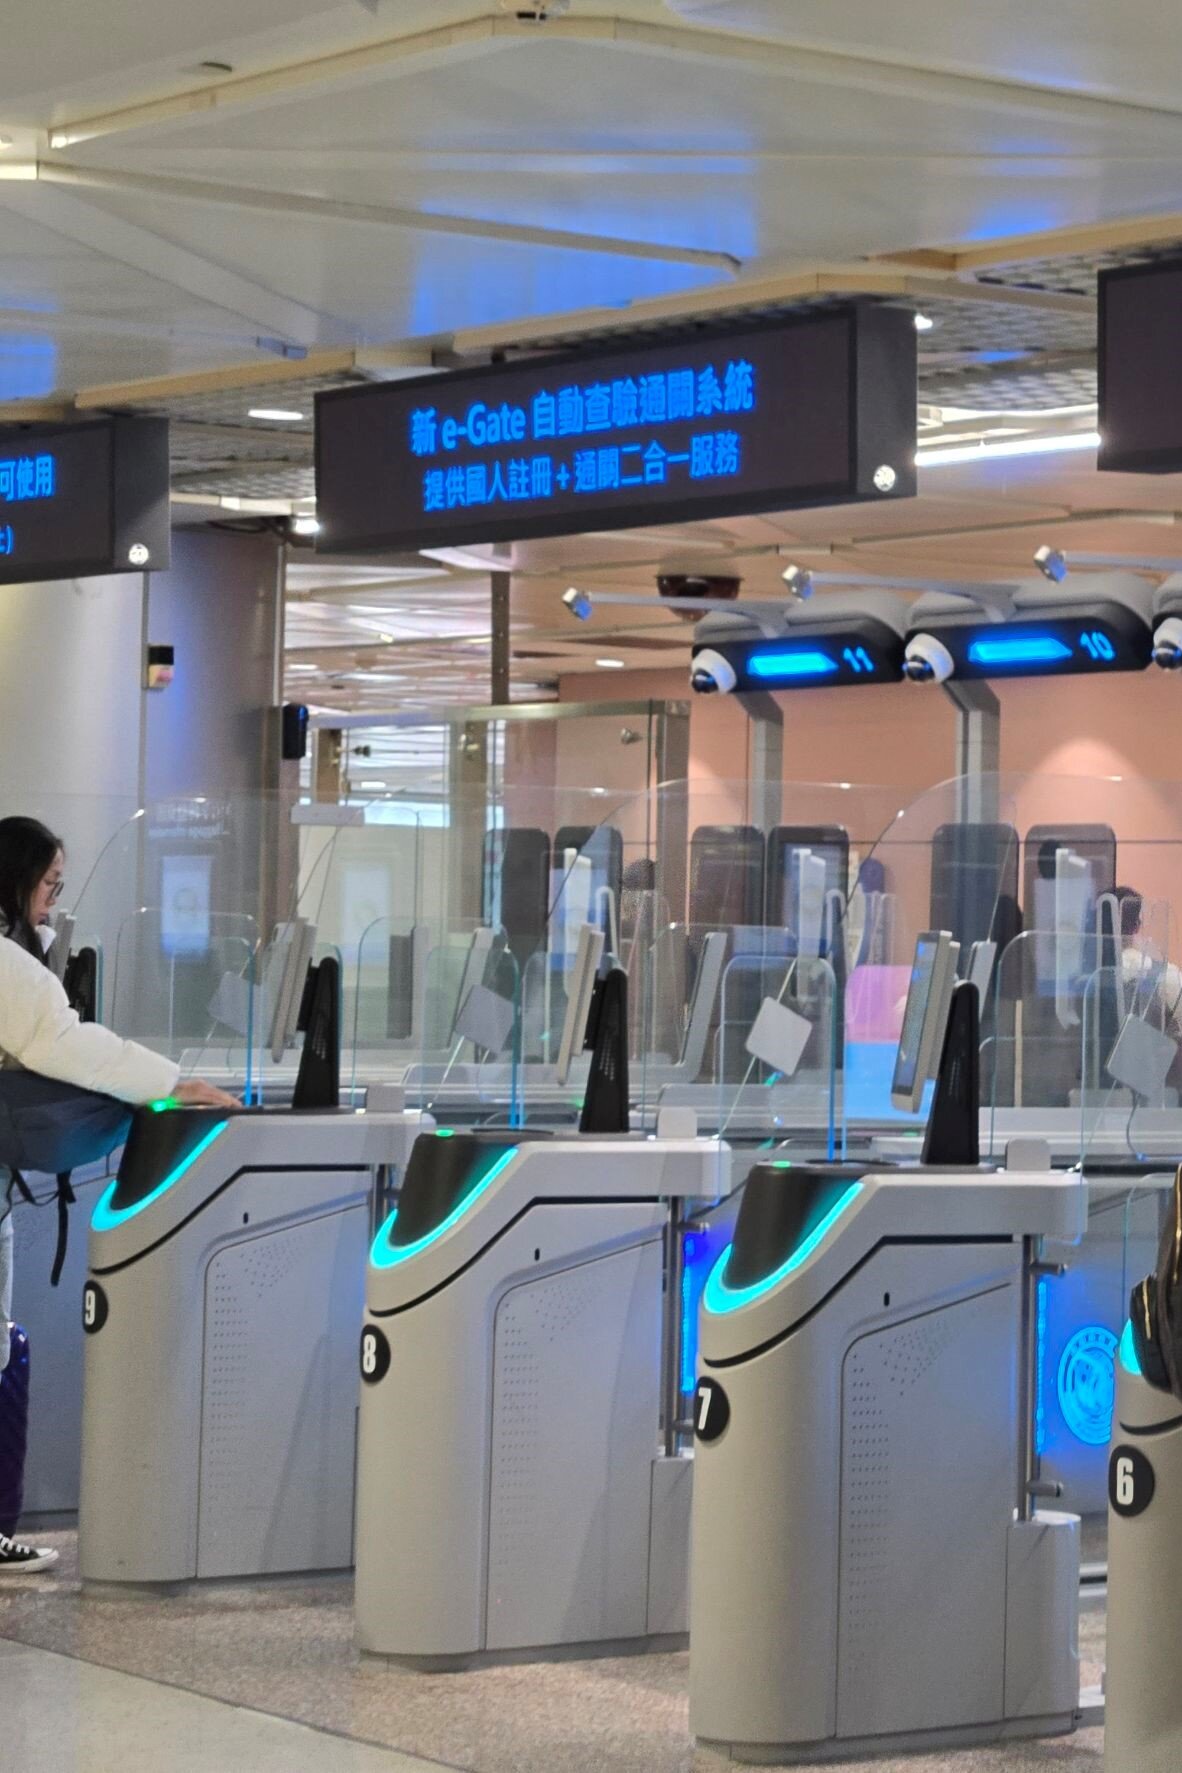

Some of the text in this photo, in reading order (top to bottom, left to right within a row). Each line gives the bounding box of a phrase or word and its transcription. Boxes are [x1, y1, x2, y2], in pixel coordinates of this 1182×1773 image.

[411, 360, 753, 456] 新 e-Gate 自動查驗通關系統
[424, 456, 552, 511] 提供國人註冊
[574, 431, 739, 492] 通關二合一服務
[842, 646, 874, 673] 11
[1078, 631, 1115, 660] 10
[84, 1290, 96, 1325] 9
[363, 1333, 377, 1374] 8
[697, 1387, 712, 1430] 7
[1116, 1456, 1134, 1506] 6
